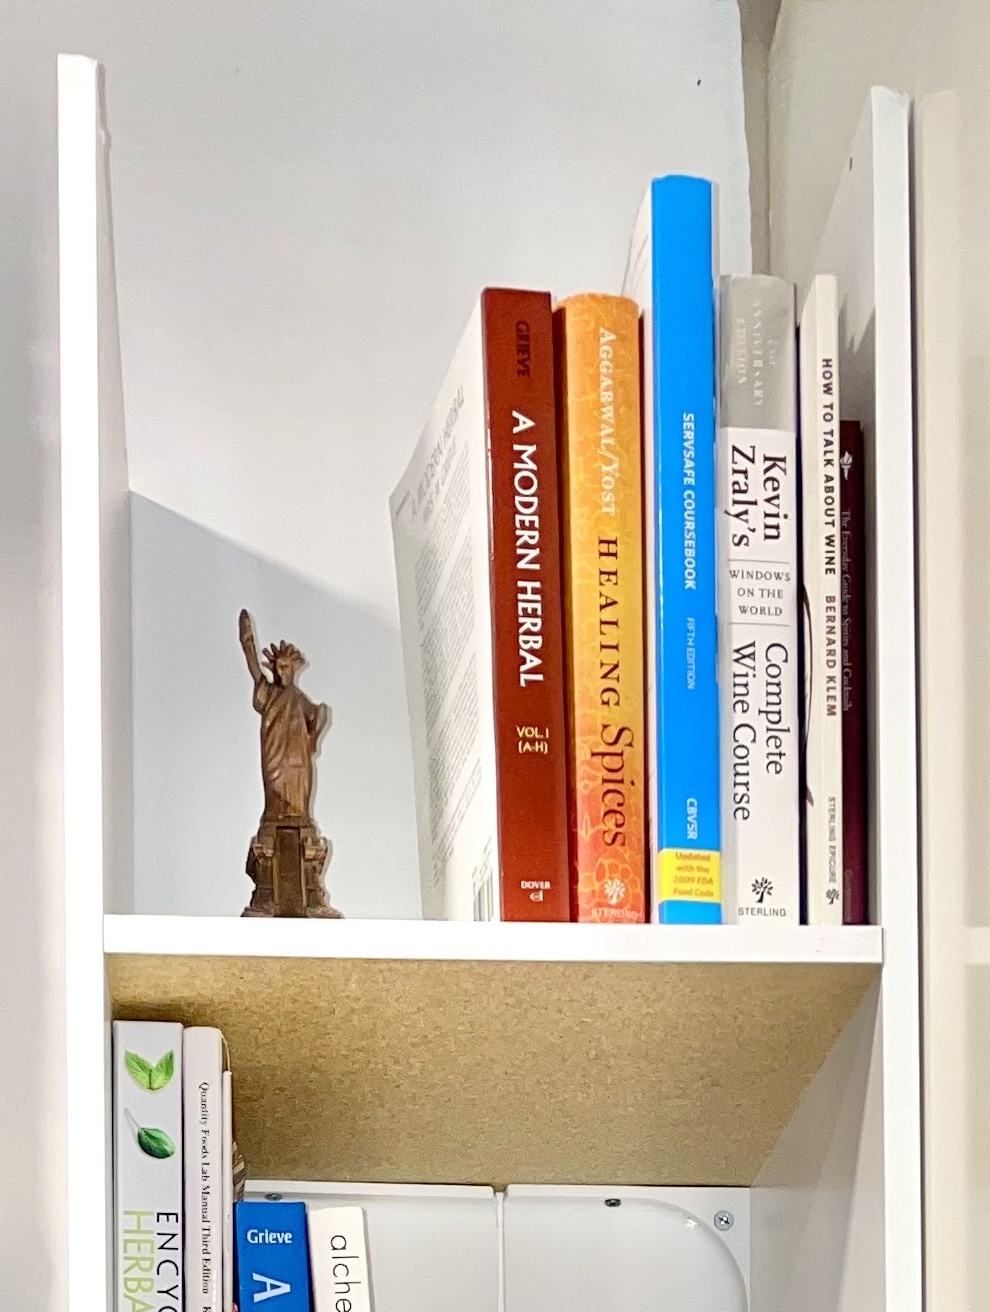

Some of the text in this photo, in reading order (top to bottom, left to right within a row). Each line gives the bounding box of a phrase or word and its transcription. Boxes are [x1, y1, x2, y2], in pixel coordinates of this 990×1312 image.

[516, 320, 530, 378] GRIEVE
[822, 358, 836, 576] HOW TO TALK ABOUT WINE
[682, 412, 696, 590] SERVSAFE COURSEBOOK
[724, 444, 758, 548] Zraly's
[763, 454, 789, 542] Kevin
[841, 510, 852, 528] The
[512, 410, 544, 688] A MODERN HERBAL
[841, 530, 852, 572] Everyday
[729, 569, 791, 582] WINDOWS
[737, 588, 784, 600] ON THE
[841, 574, 852, 603] Guide
[738, 605, 783, 616] WORLD
[841, 618, 852, 647] Spirits
[686, 648, 696, 690] EDITION
[825, 594, 837, 717] BERNARD KLEM
[842, 648, 852, 666] and
[590, 536, 635, 848] HEALING Spices
[758, 642, 790, 775] Complete
[842, 668, 852, 712] Cocktails
[516, 726, 549, 738] VOL. I
[732, 640, 756, 822] Wine Course
[828, 796, 837, 884] STERLING EPICURE
[520, 880, 551, 890] DOVER
[590, 908, 639, 920] STERLING
[738, 907, 786, 918] STERLING
[198, 1081, 212, 1294] Quantity Foods Lab Manual Third Edition
[246, 1229, 293, 1244] Grieve
[252, 1272, 292, 1304] A
